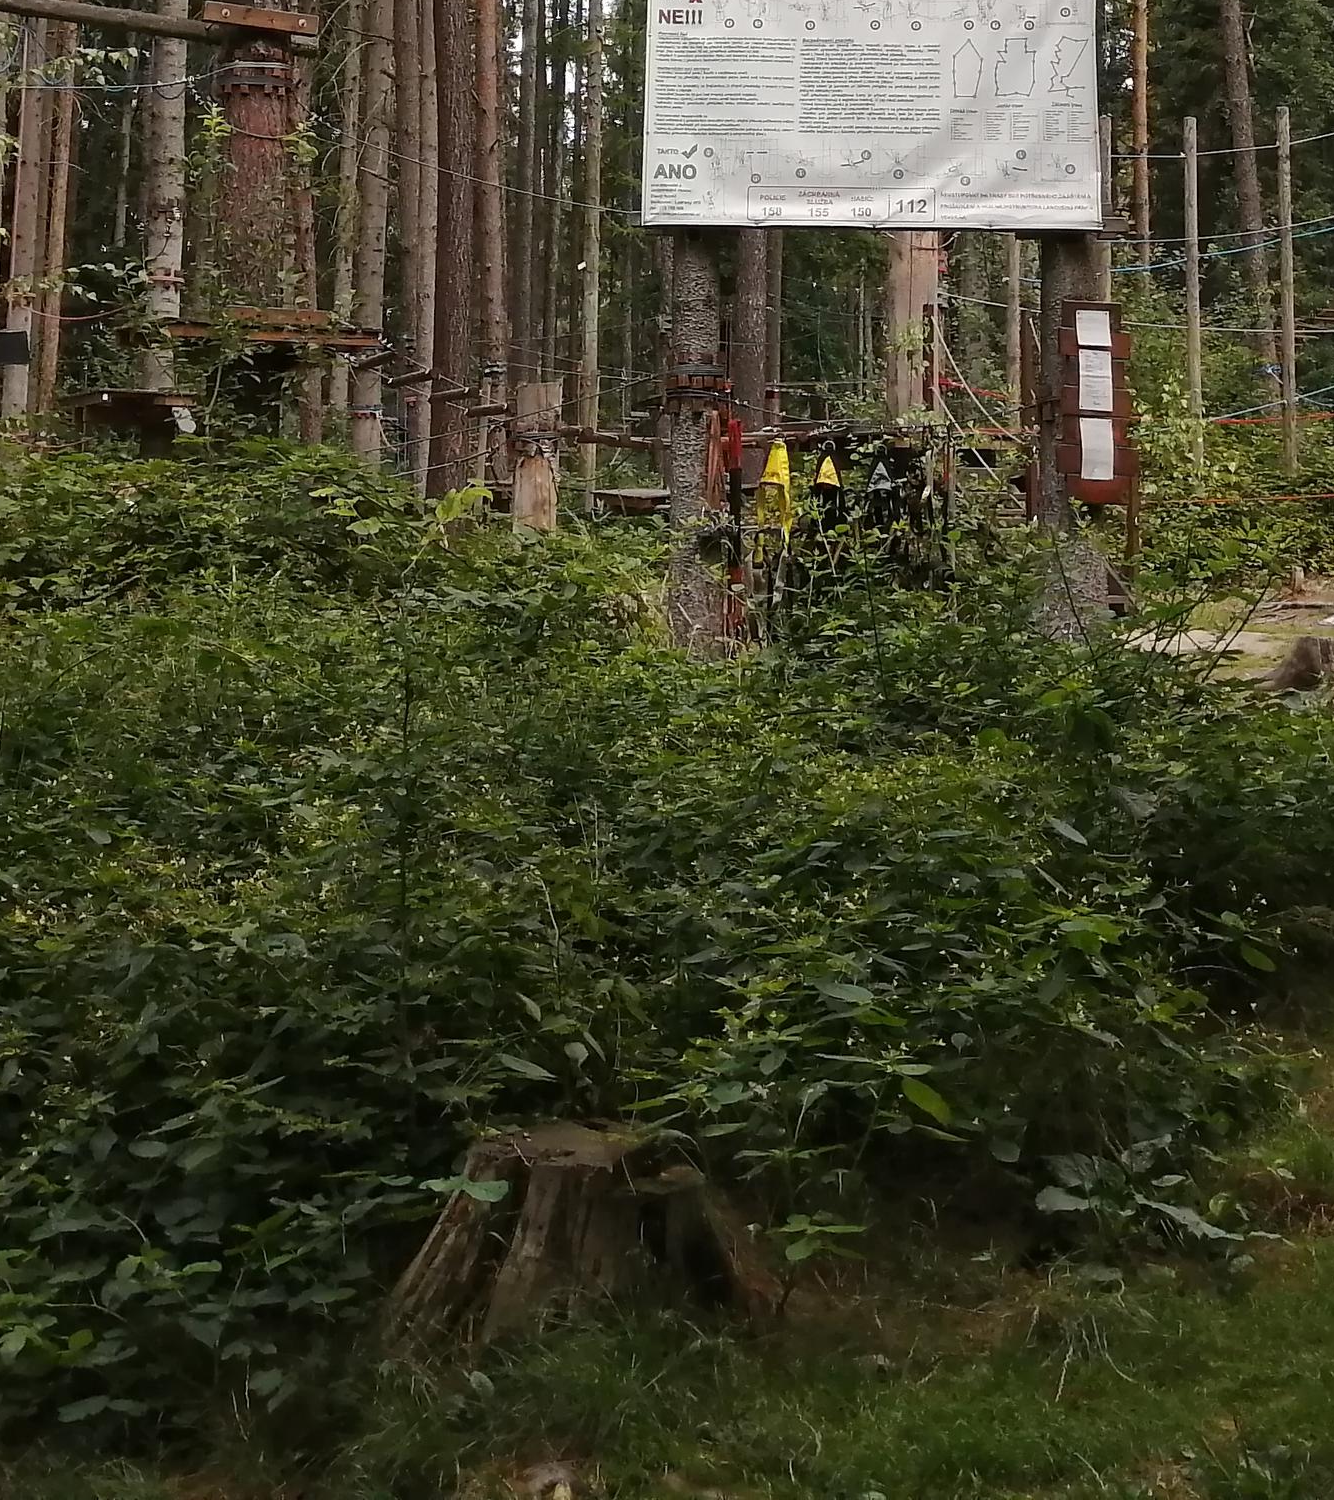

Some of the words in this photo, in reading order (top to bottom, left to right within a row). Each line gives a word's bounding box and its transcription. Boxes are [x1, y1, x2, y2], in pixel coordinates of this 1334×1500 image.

[658, 9, 703, 25] NE!!!
[653, 163, 697, 180] ANO
[808, 207, 830, 217] 155
[850, 207, 872, 217] 150
[895, 198, 928, 214] 112
